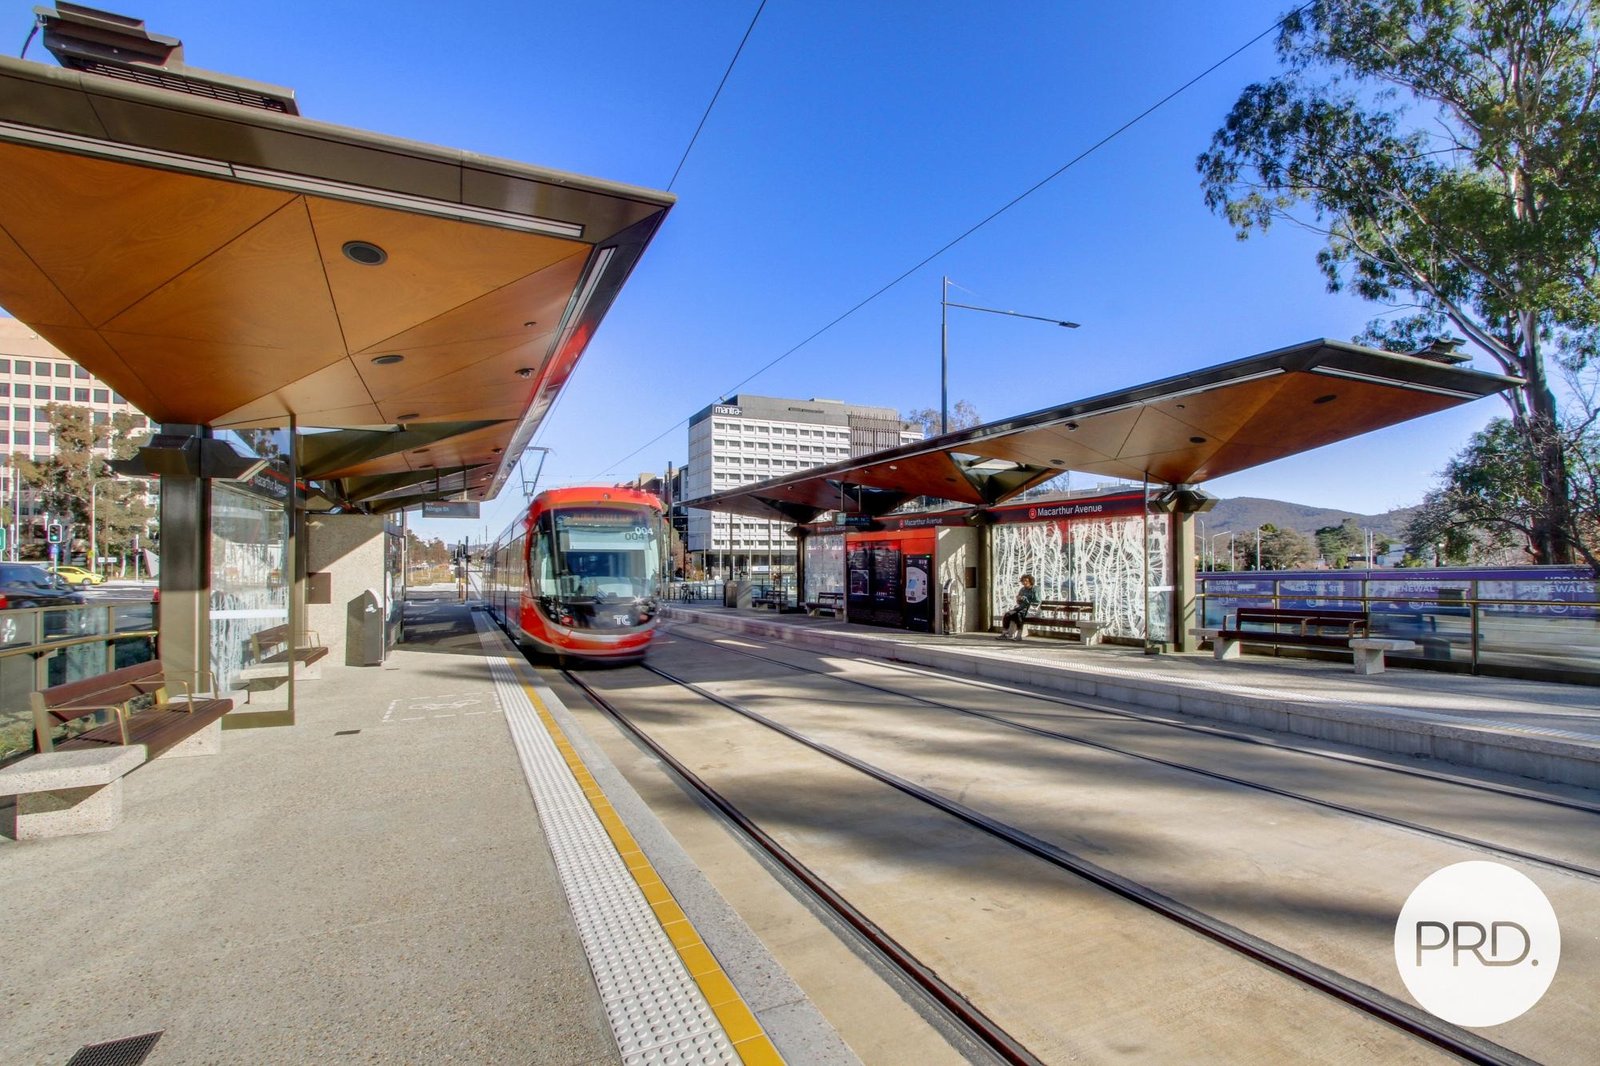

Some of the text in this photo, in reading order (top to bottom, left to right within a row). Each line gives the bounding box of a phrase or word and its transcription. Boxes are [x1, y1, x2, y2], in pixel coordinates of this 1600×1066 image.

[1037, 504, 1103, 516] Macarthur Avenue
[634, 526, 654, 535] 004
[1523, 585, 1584, 593] RENEWAL
[613, 614, 631, 626] TC
